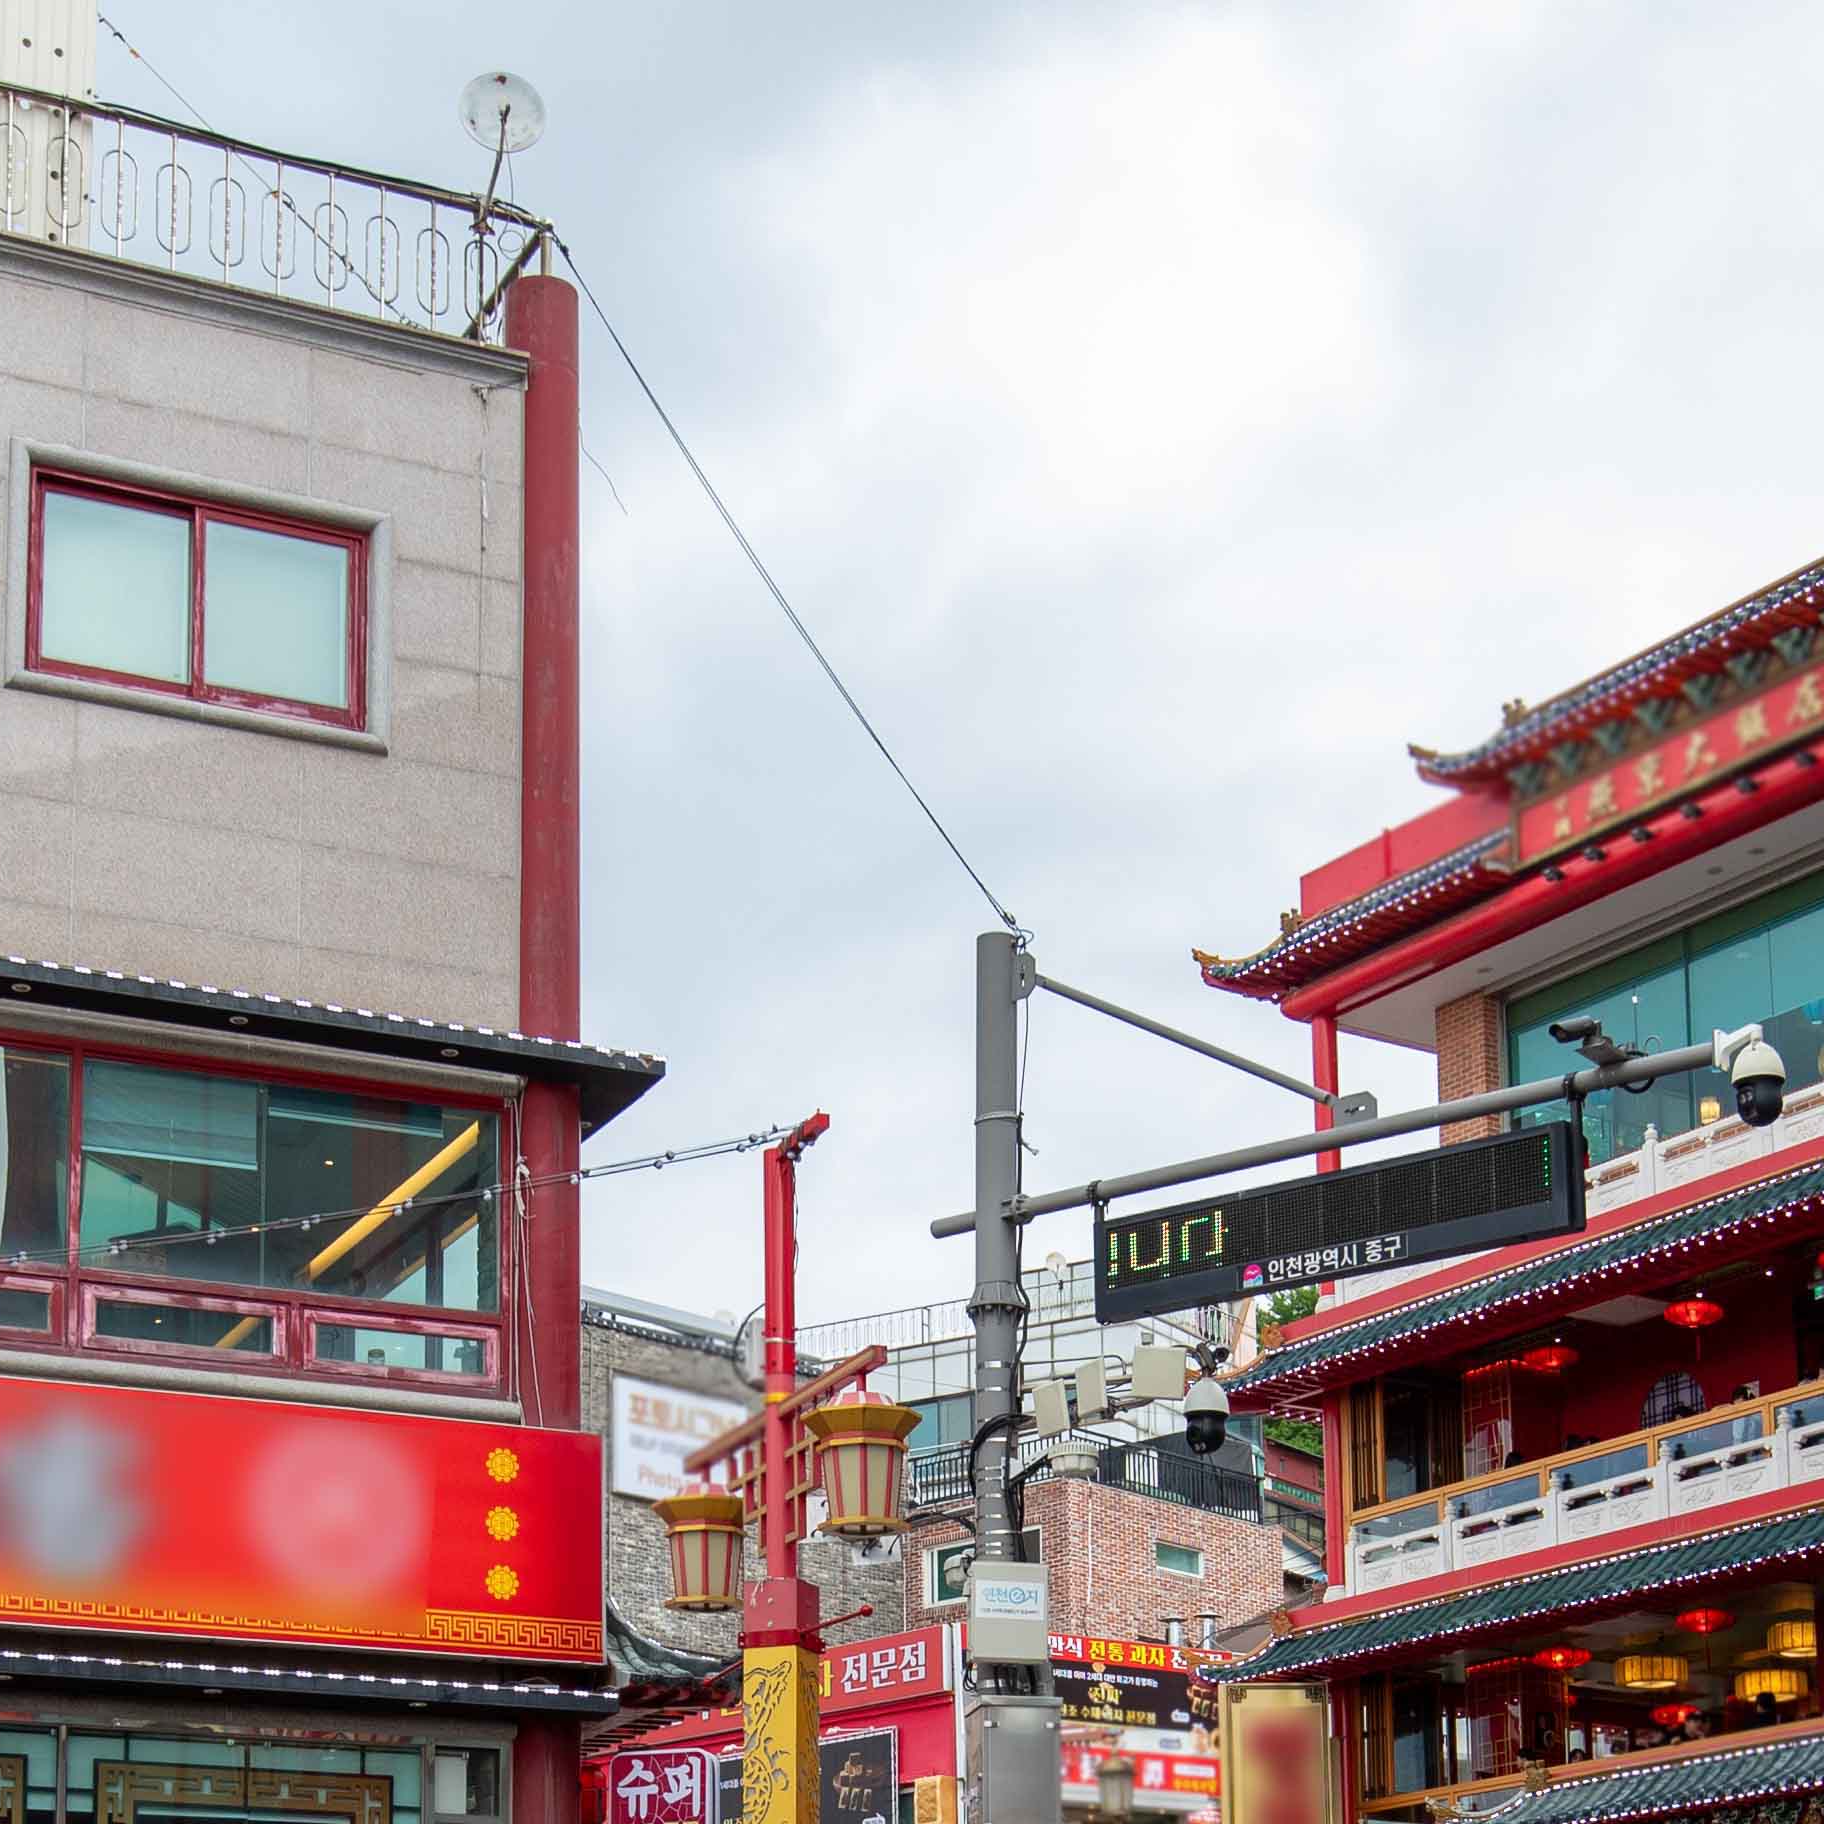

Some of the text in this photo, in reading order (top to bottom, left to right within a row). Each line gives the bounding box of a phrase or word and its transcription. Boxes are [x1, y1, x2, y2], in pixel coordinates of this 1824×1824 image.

[1267, 1234, 1402, 1282] 인천광역시 중구
[840, 1640, 927, 1694] 전문점
[1088, 1639, 1123, 1662] 전통
[1129, 1643, 1166, 1667] 과자
[616, 1756, 701, 1820] 슈퍼
